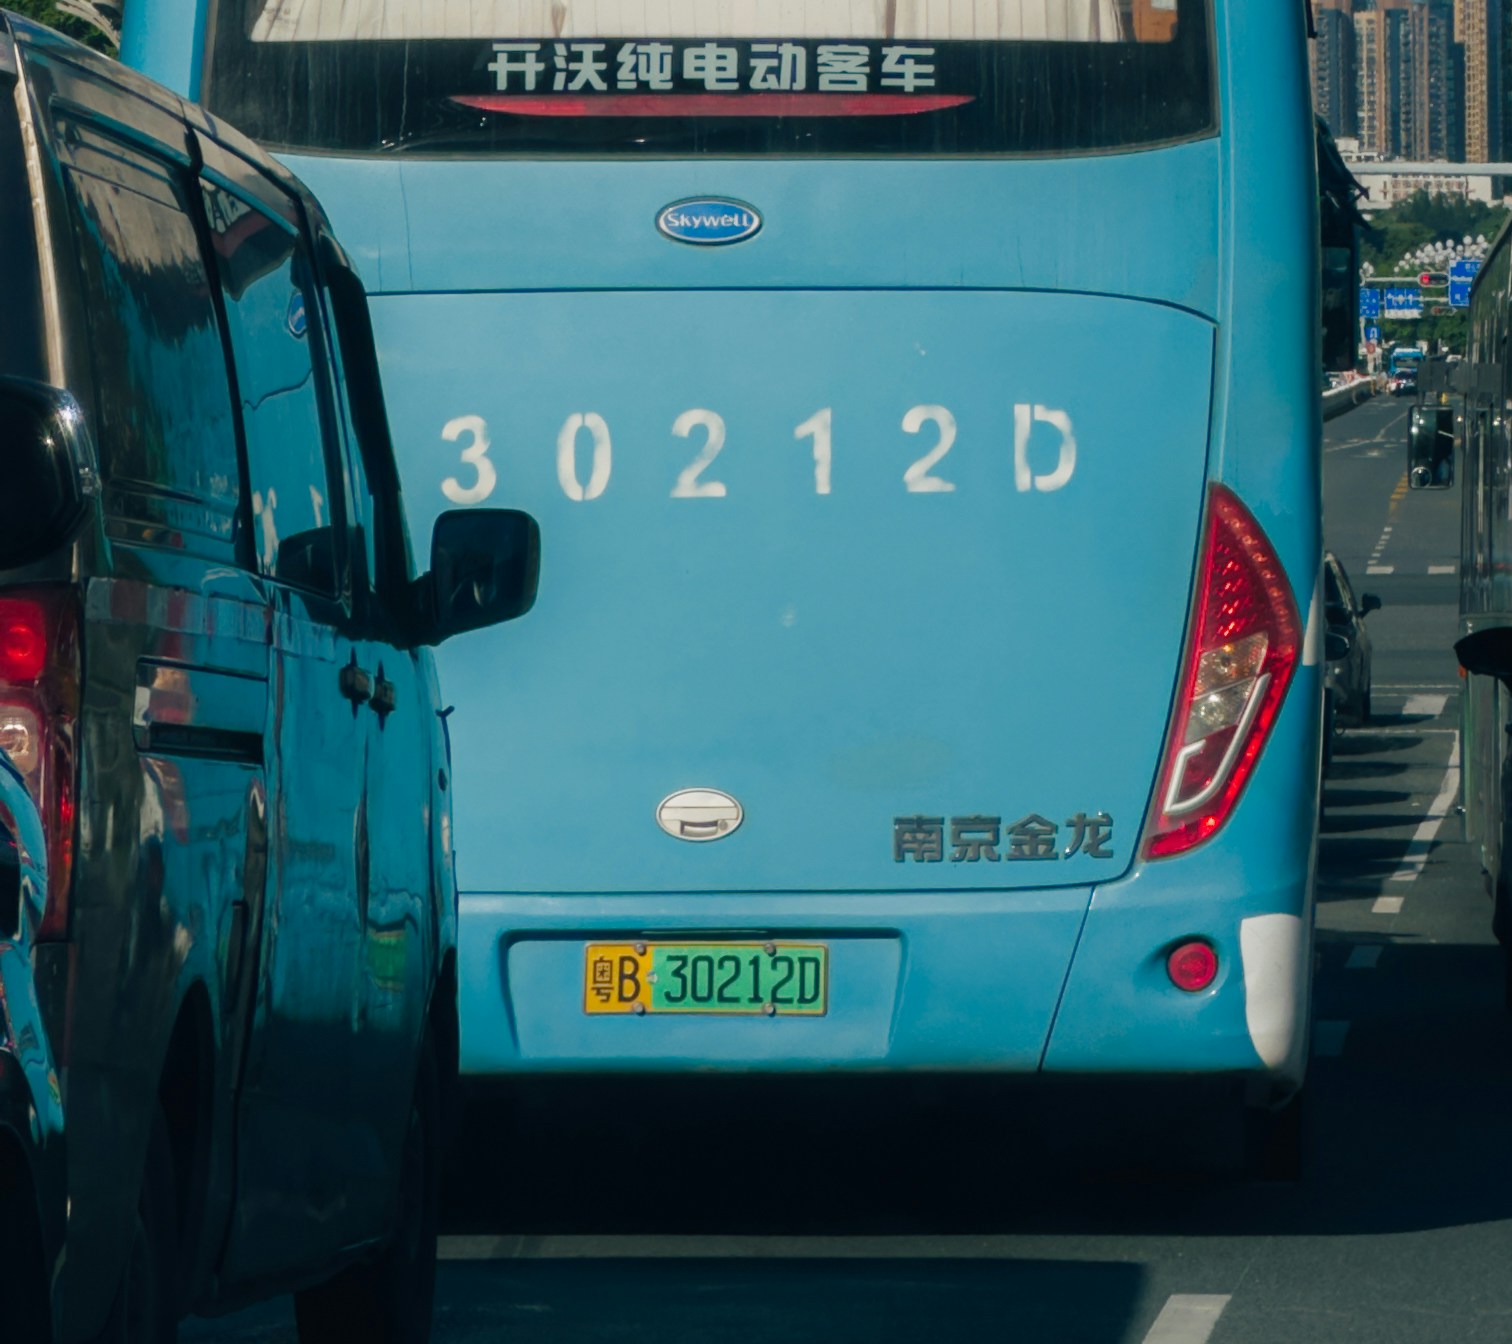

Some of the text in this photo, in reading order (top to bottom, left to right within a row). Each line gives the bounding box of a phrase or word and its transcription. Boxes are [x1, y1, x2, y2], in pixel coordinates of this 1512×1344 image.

[488, 42, 936, 92] 开沃纯电动客车
[667, 213, 751, 229] Skywell
[893, 813, 1114, 862] 南京金龙
